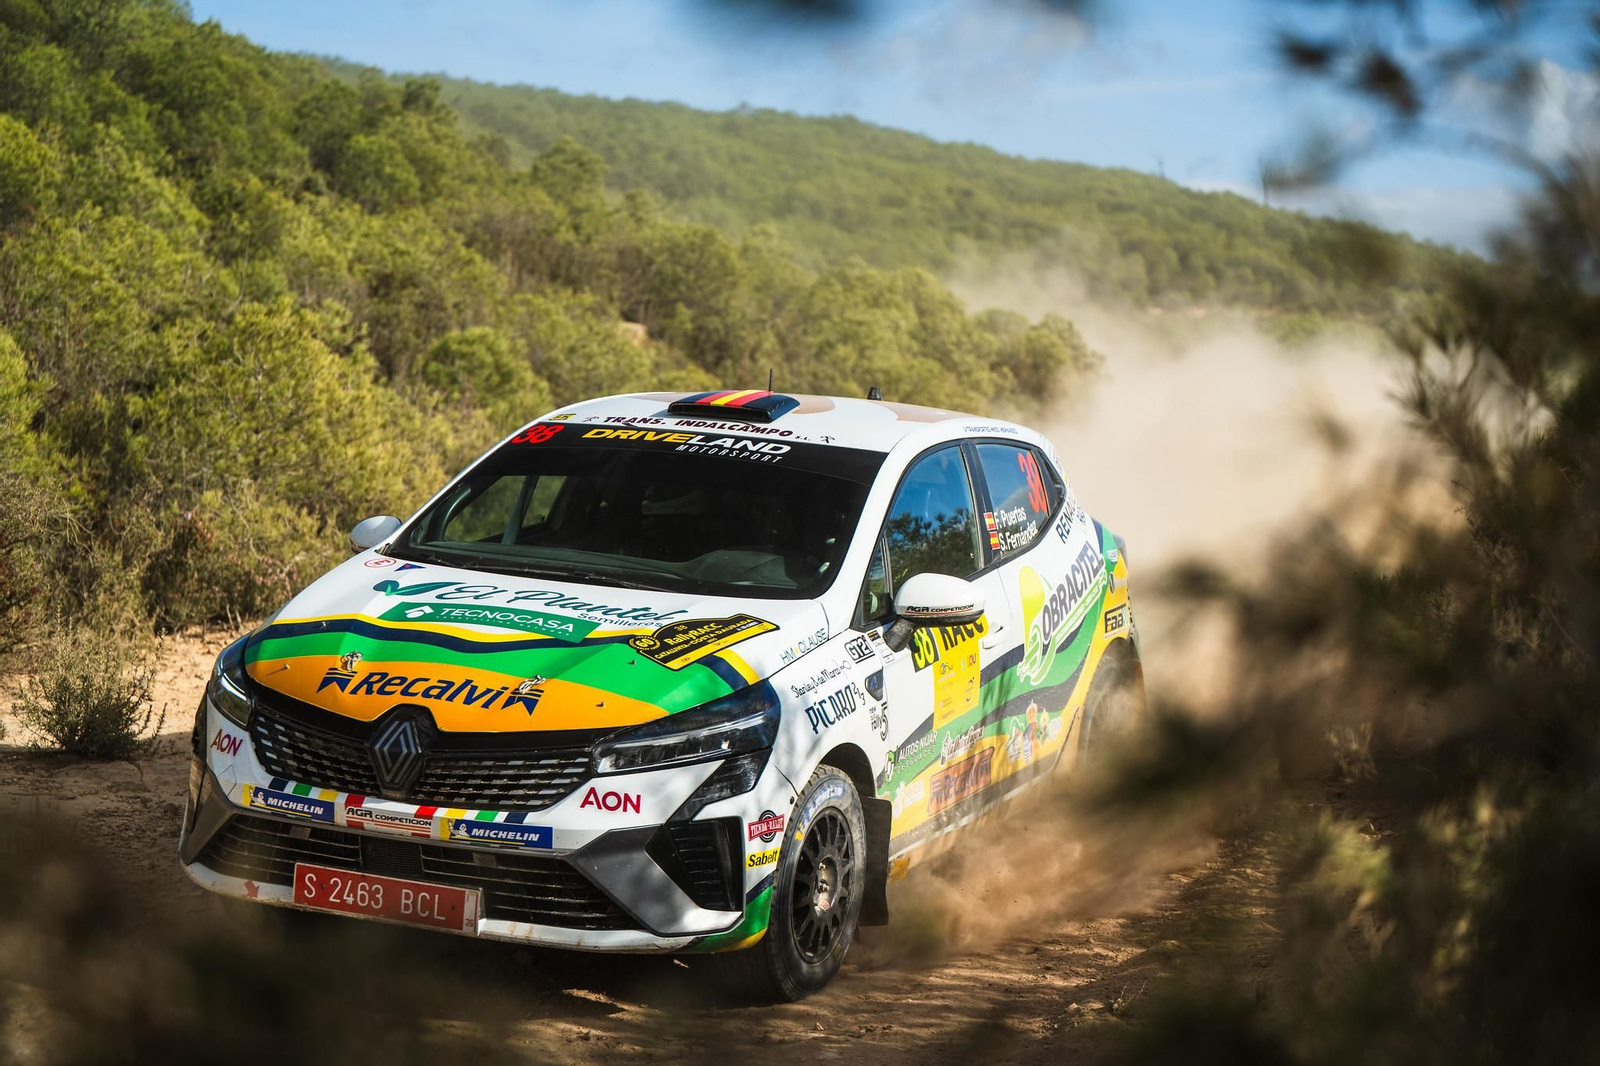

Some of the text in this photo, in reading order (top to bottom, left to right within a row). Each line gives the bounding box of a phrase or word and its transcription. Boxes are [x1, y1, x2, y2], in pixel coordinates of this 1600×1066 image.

[512, 424, 565, 444] 38
[603, 416, 666, 427] TRANS.
[675, 419, 794, 437] INDALCAMPO
[581, 428, 792, 455] DRIVELAND
[675, 444, 783, 463] MOTORSPORT
[1017, 452, 1048, 513] 38
[1042, 540, 1105, 642] OBRACITEL
[506, 590, 689, 621] Plantel
[906, 605, 930, 613] AGR
[439, 608, 574, 633] TECNOCASA
[577, 613, 664, 628] Semilleros
[635, 638, 655, 648] 60
[663, 622, 723, 646] RallyRACC
[798, 628, 828, 653] CLAUSE
[914, 627, 935, 669] 38
[348, 671, 510, 710] Recalvi
[210, 728, 244, 757] AON
[267, 797, 324, 815] MICHELIN
[579, 786, 642, 814] AON
[346, 807, 432, 827] AGR COMPETICION
[470, 827, 540, 842] MICHELIN
[747, 850, 778, 868] Sabelt
[304, 873, 446, 920] S 2463 BCL
